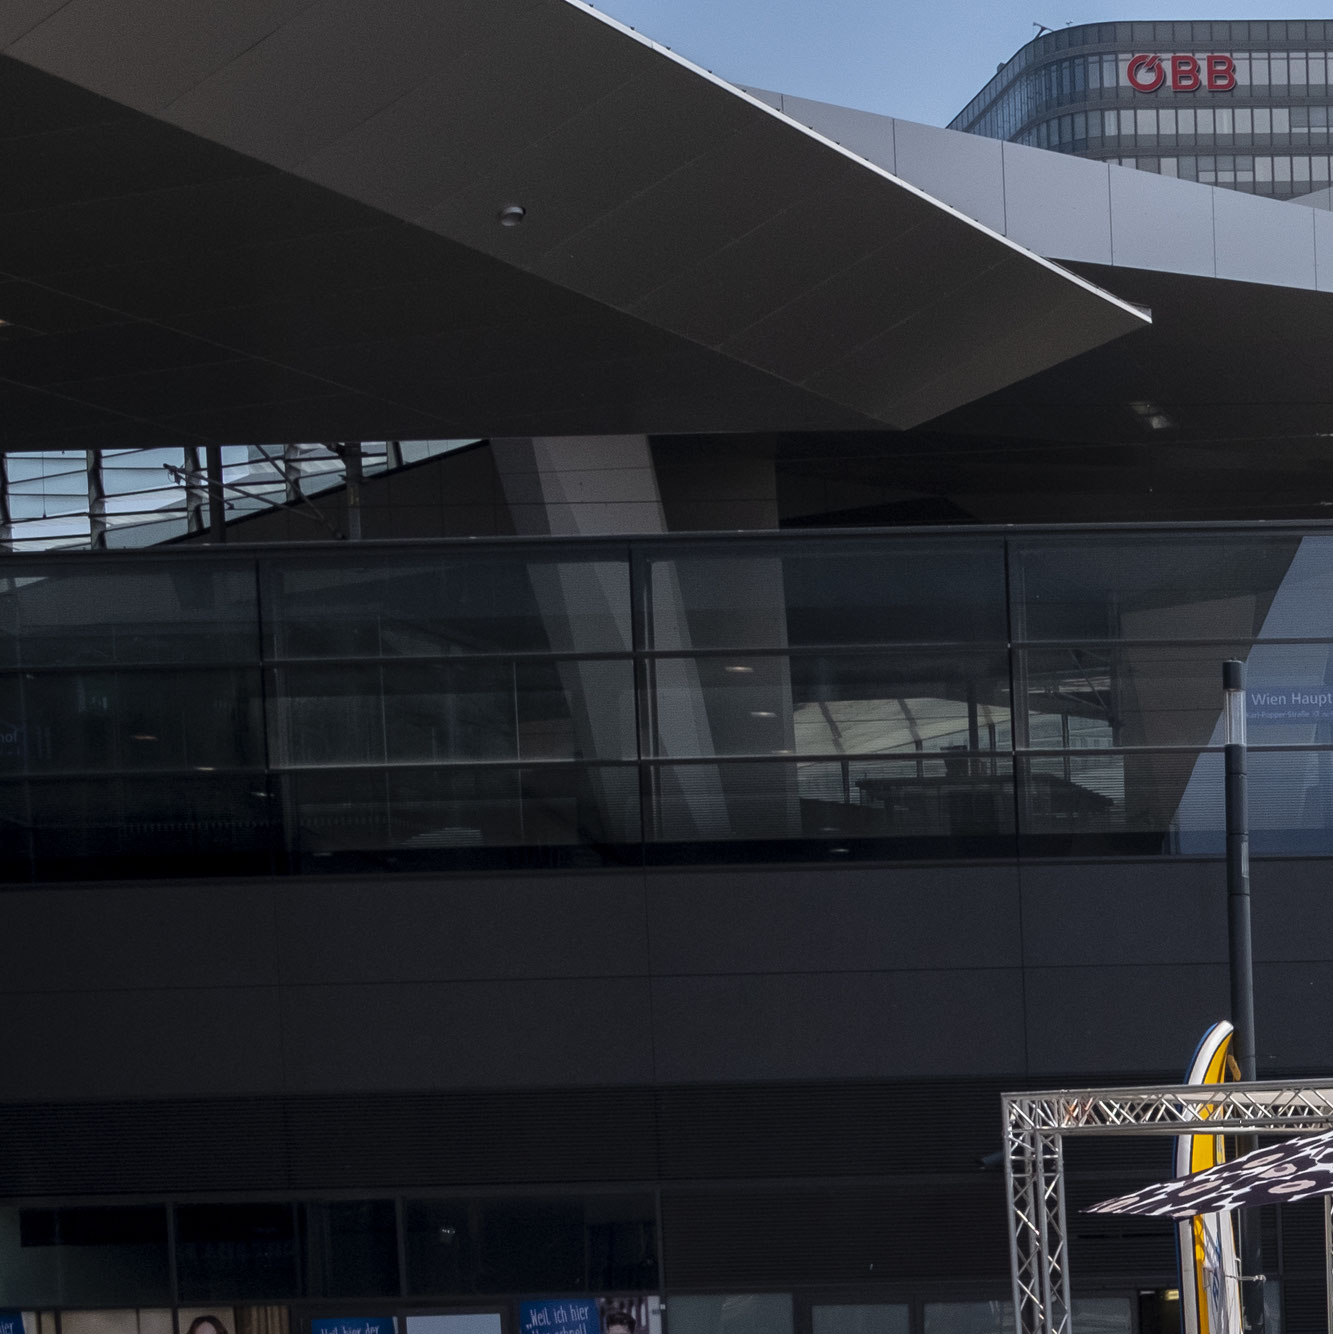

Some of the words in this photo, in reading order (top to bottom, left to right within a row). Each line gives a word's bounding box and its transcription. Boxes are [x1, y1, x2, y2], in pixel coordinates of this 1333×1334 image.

[1251, 692, 1287, 706] Wien
[553, 1305, 568, 1324] ich
[569, 1304, 589, 1321] hier
